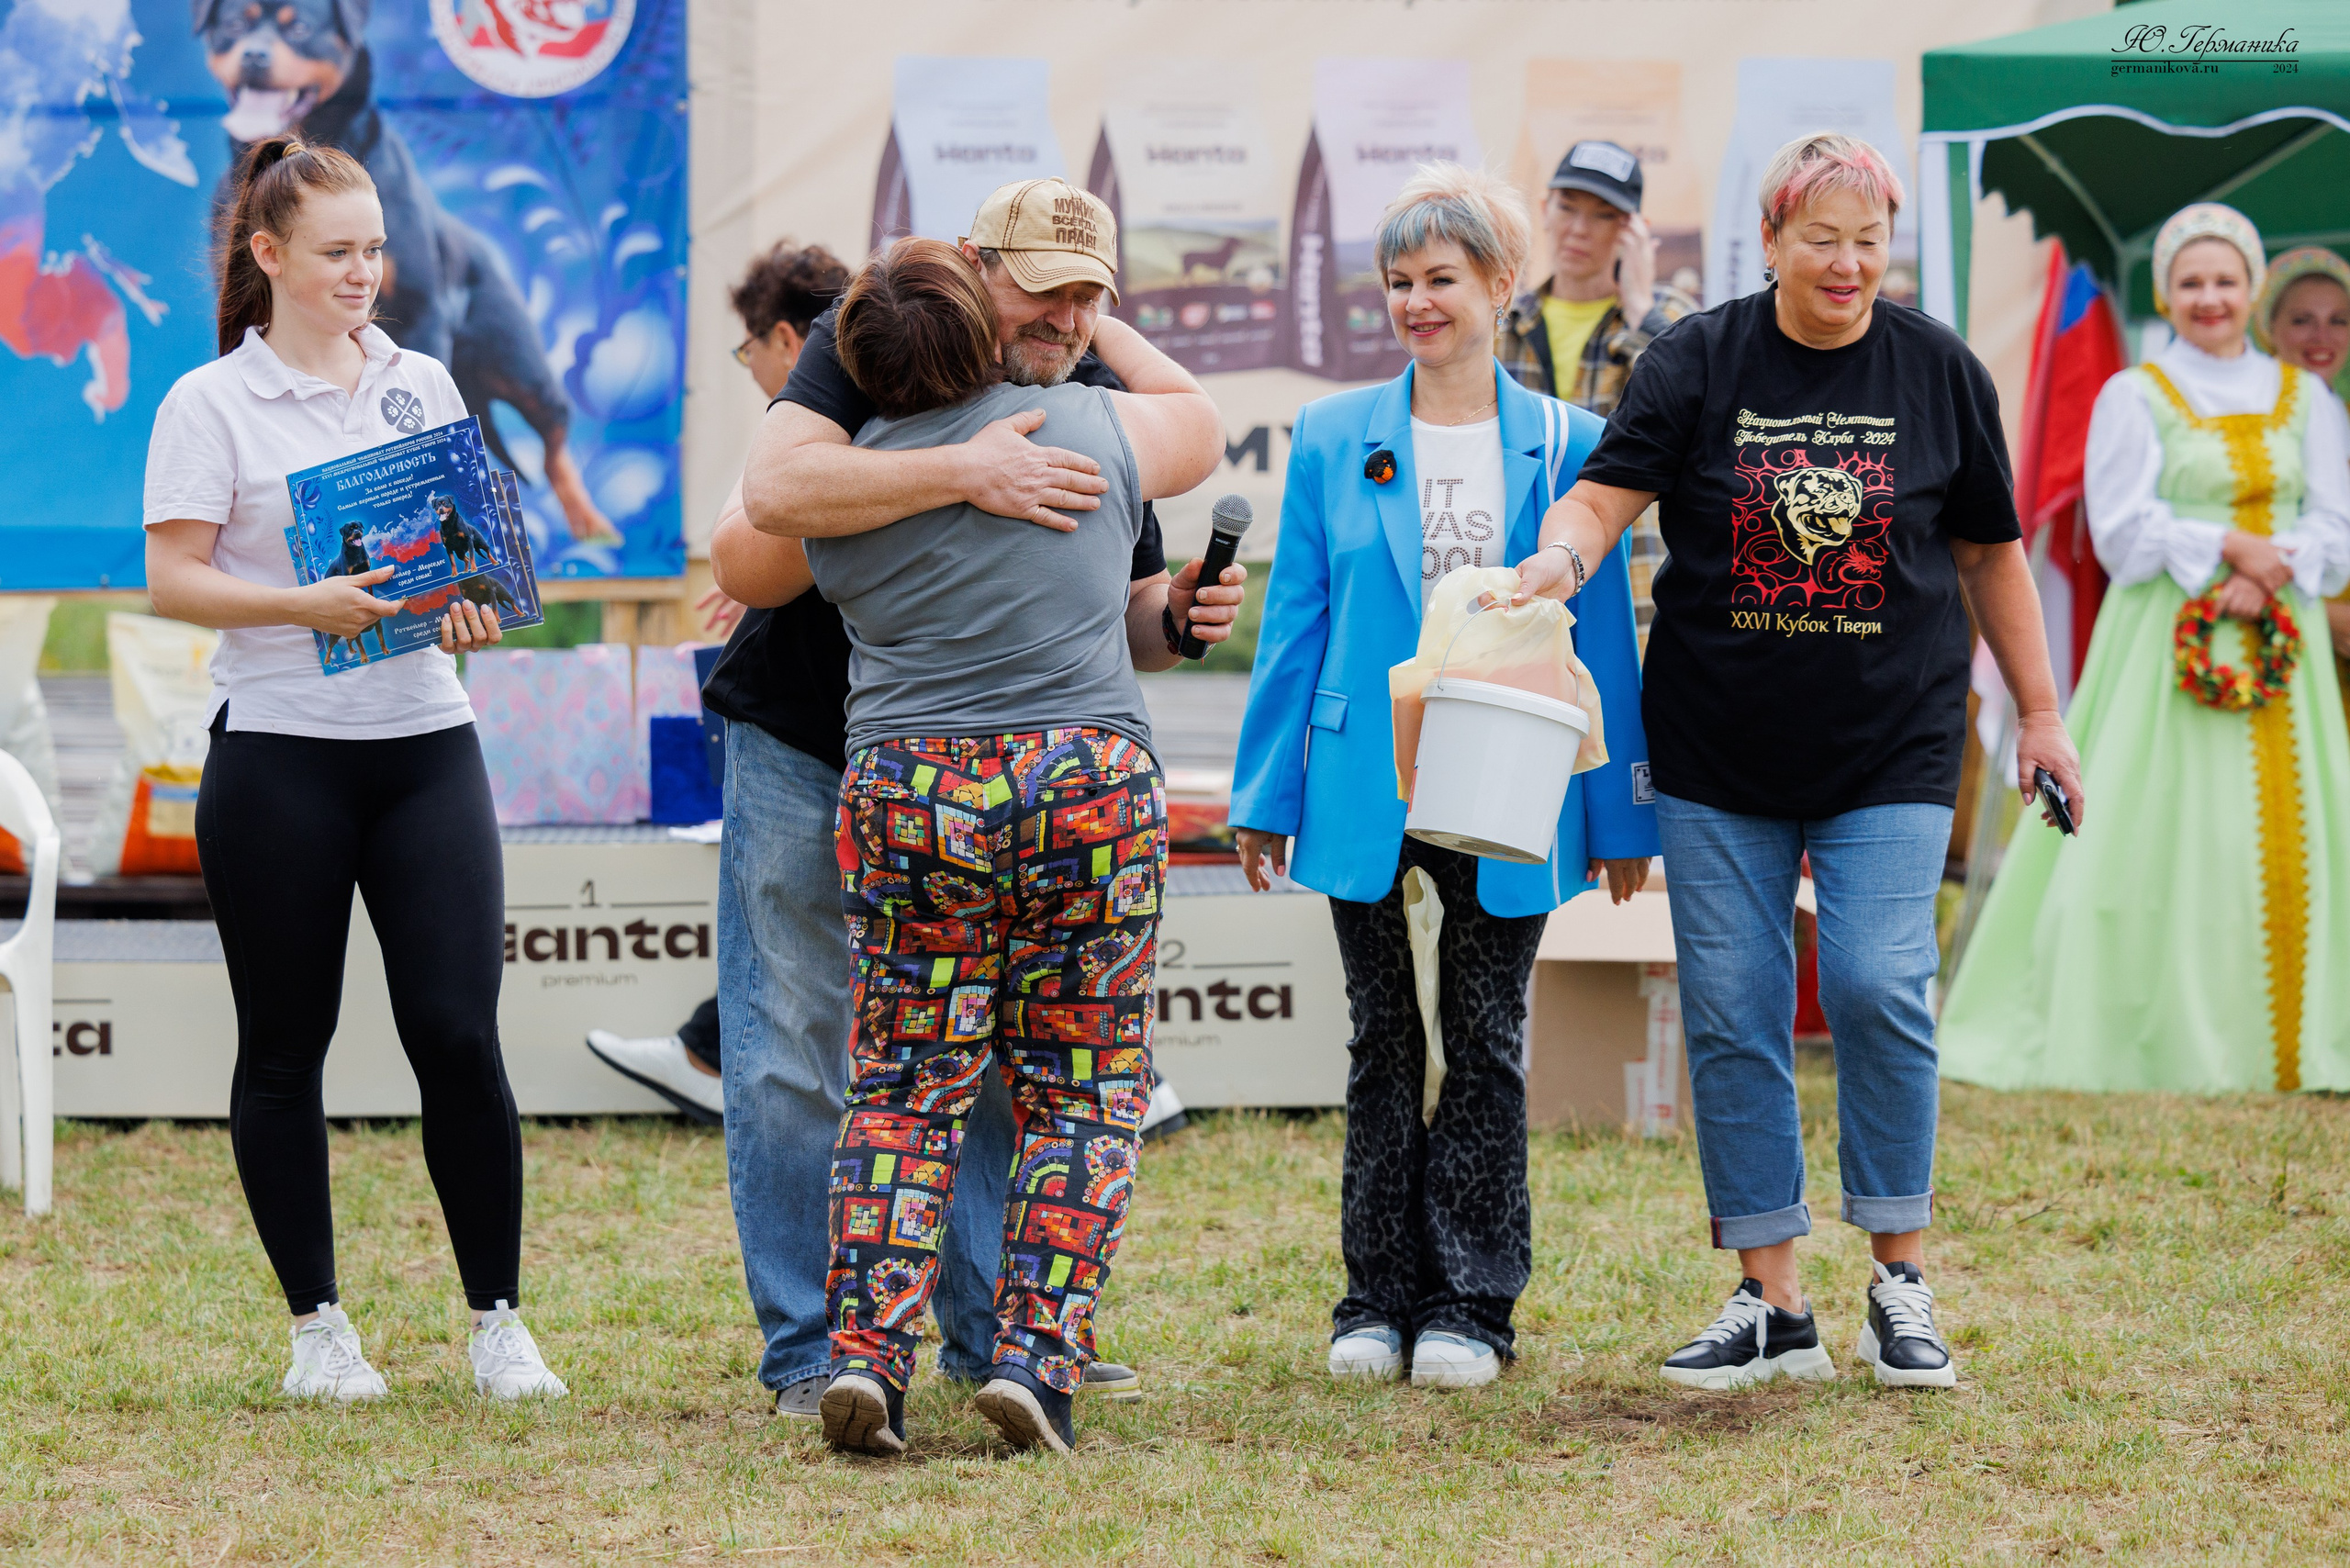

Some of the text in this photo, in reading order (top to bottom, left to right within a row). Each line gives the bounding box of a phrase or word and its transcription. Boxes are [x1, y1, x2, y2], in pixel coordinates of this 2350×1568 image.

[1055, 198, 1095, 221] МУЖИК
[1052, 215, 1098, 233] ВСЕГДА
[1056, 228, 1096, 251] ПРАВ!
[1737, 409, 1896, 430] Национальный Чемпионат
[1734, 429, 1807, 447] Победитель
[1811, 430, 1854, 446] Клуба
[336, 452, 437, 491] БЛАГОДАРНОСТЬ
[1424, 478, 1463, 508] IT
[337, 501, 358, 511] Самым
[373, 499, 391, 509] только
[418, 558, 446, 571] Мерседес
[397, 570, 432, 587] среди собак!
[394, 622, 428, 634] Ротвейлер
[413, 629, 431, 638] среди
[1730, 610, 1883, 640] XXVI Кубок Твери
[580, 879, 602, 908] 1
[1160, 939, 1186, 969] 2
[541, 972, 638, 989] premium
[1158, 978, 1292, 1023] nta
